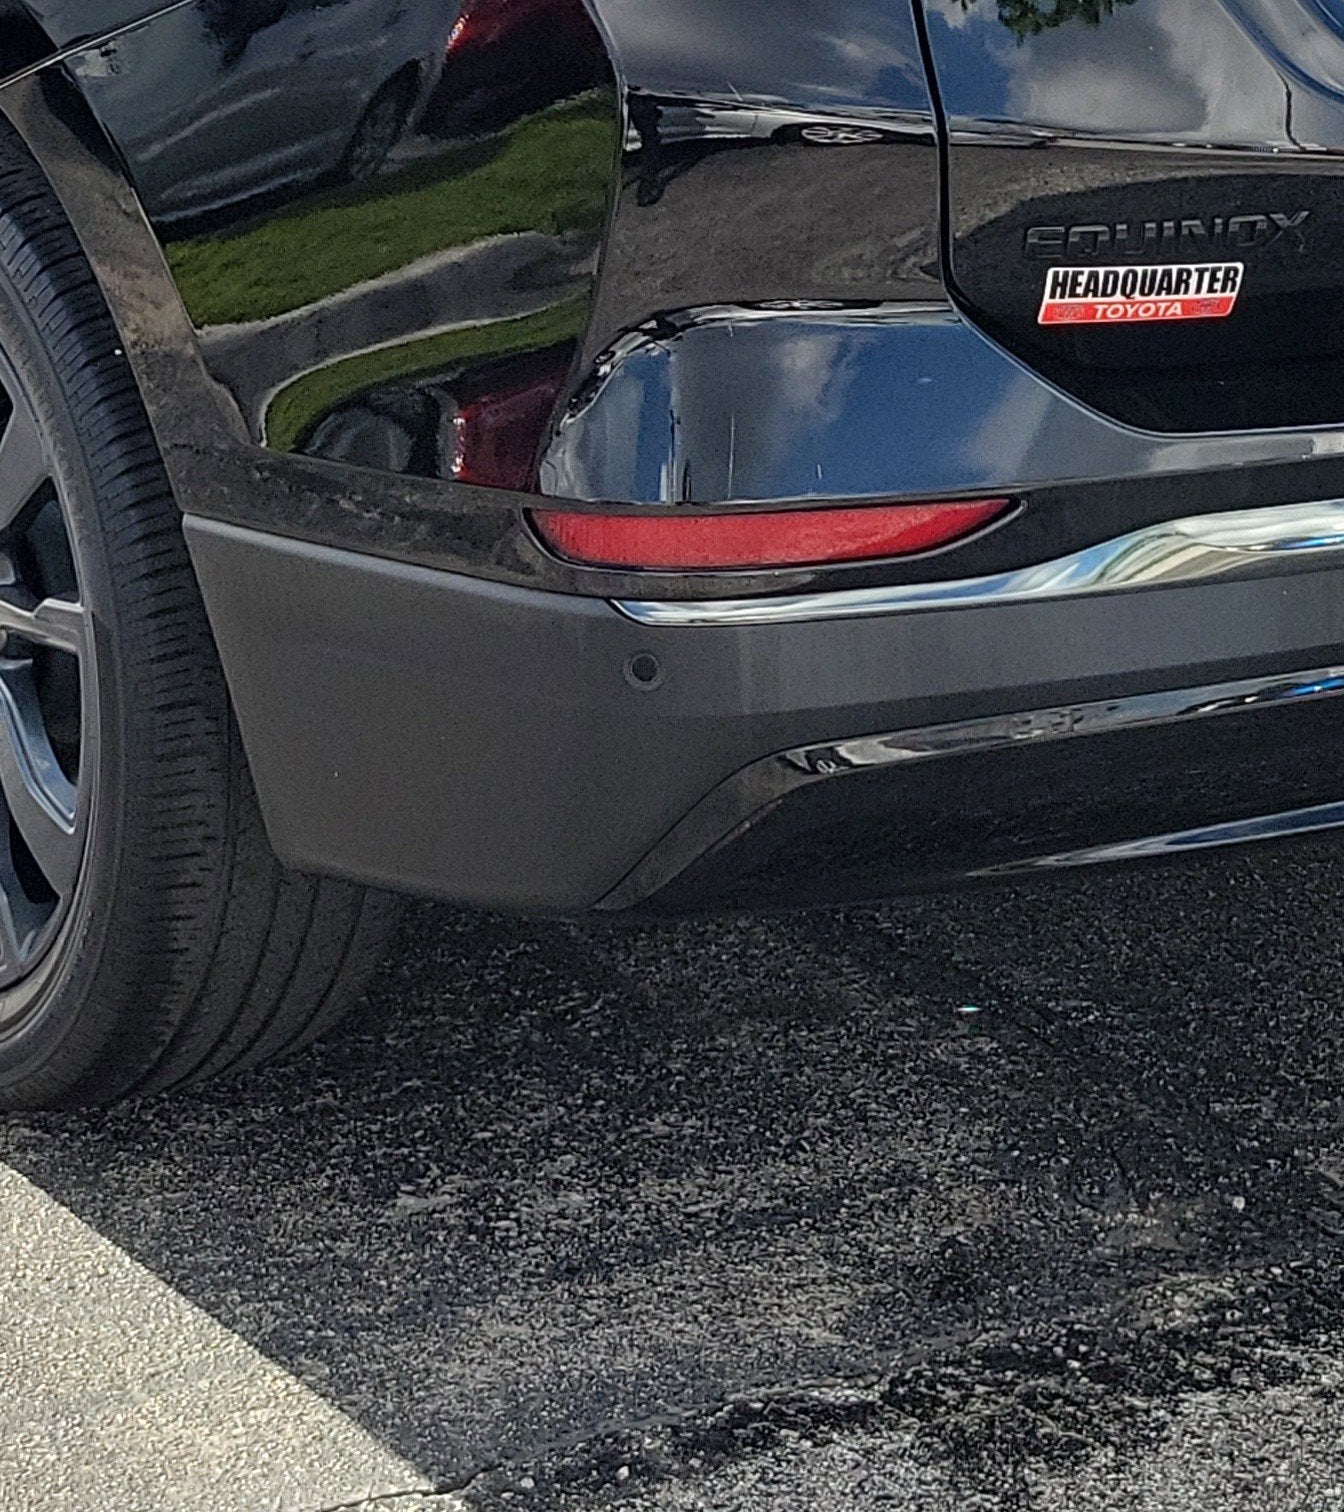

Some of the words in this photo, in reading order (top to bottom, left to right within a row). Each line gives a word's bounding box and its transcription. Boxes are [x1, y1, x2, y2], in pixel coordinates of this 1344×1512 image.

[1024, 210, 1311, 259] EQUINOX
[1049, 266, 1239, 300] HEADQUARTER
[1094, 301, 1184, 319] TOYOTA
